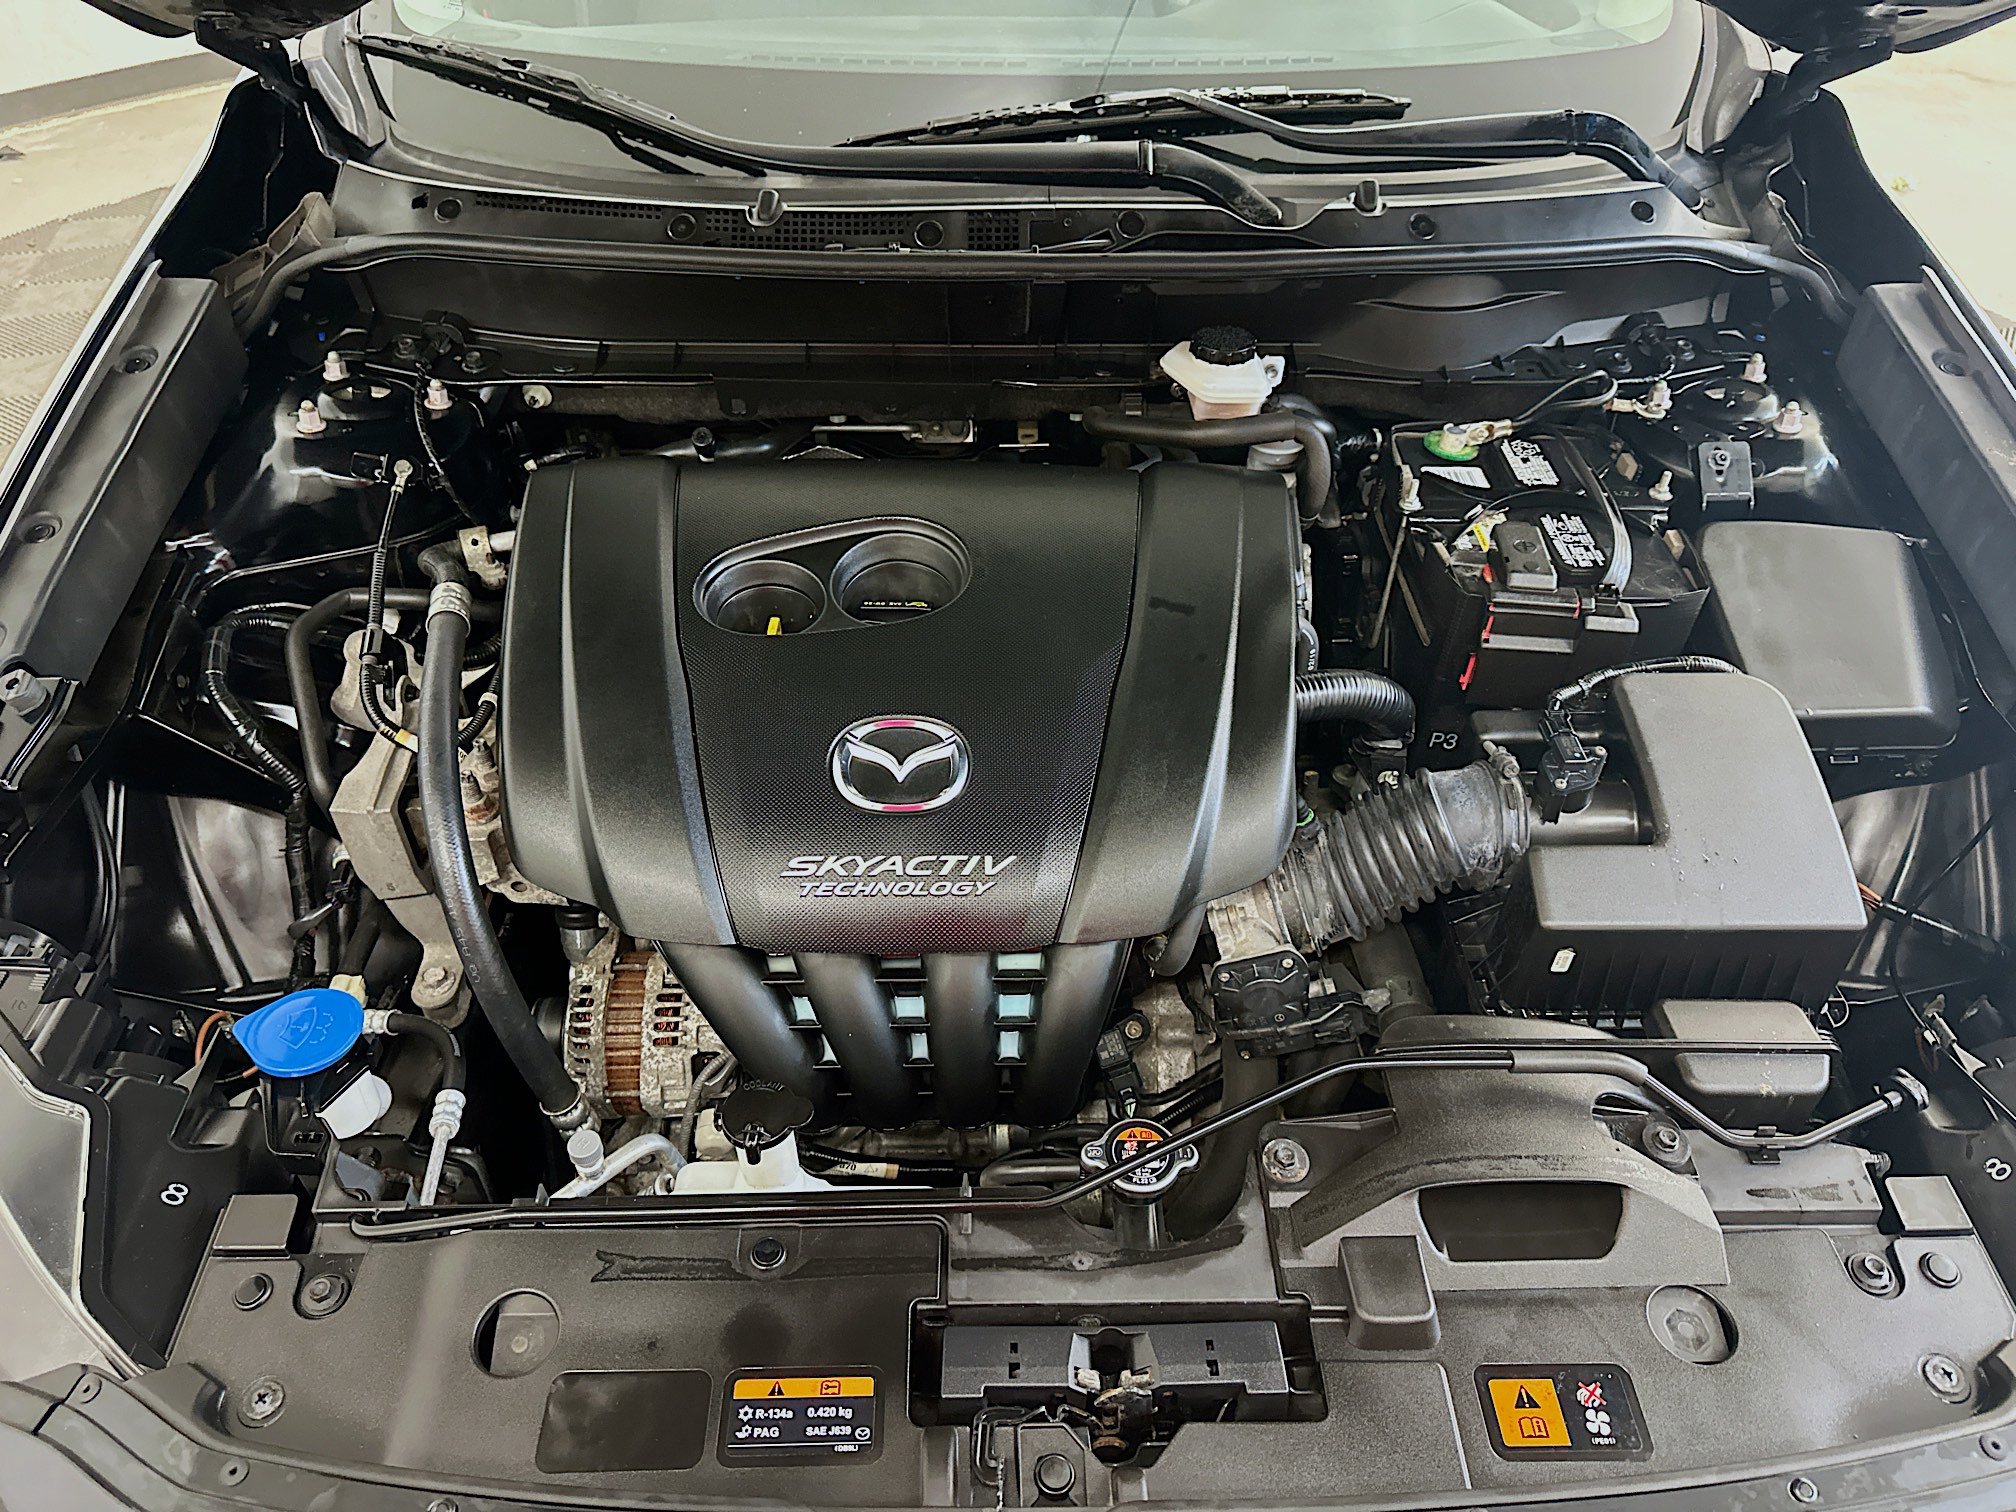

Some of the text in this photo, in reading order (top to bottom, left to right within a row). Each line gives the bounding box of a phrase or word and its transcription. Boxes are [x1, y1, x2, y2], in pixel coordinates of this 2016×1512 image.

[1429, 732, 1458, 749] P3
[780, 855, 1017, 877] SKYACTIV
[800, 881, 997, 897] TECHNOLOGY
[755, 1406, 853, 1419] R-134a 0.420 kg
[753, 1426, 852, 1438] PAG SAE J639
